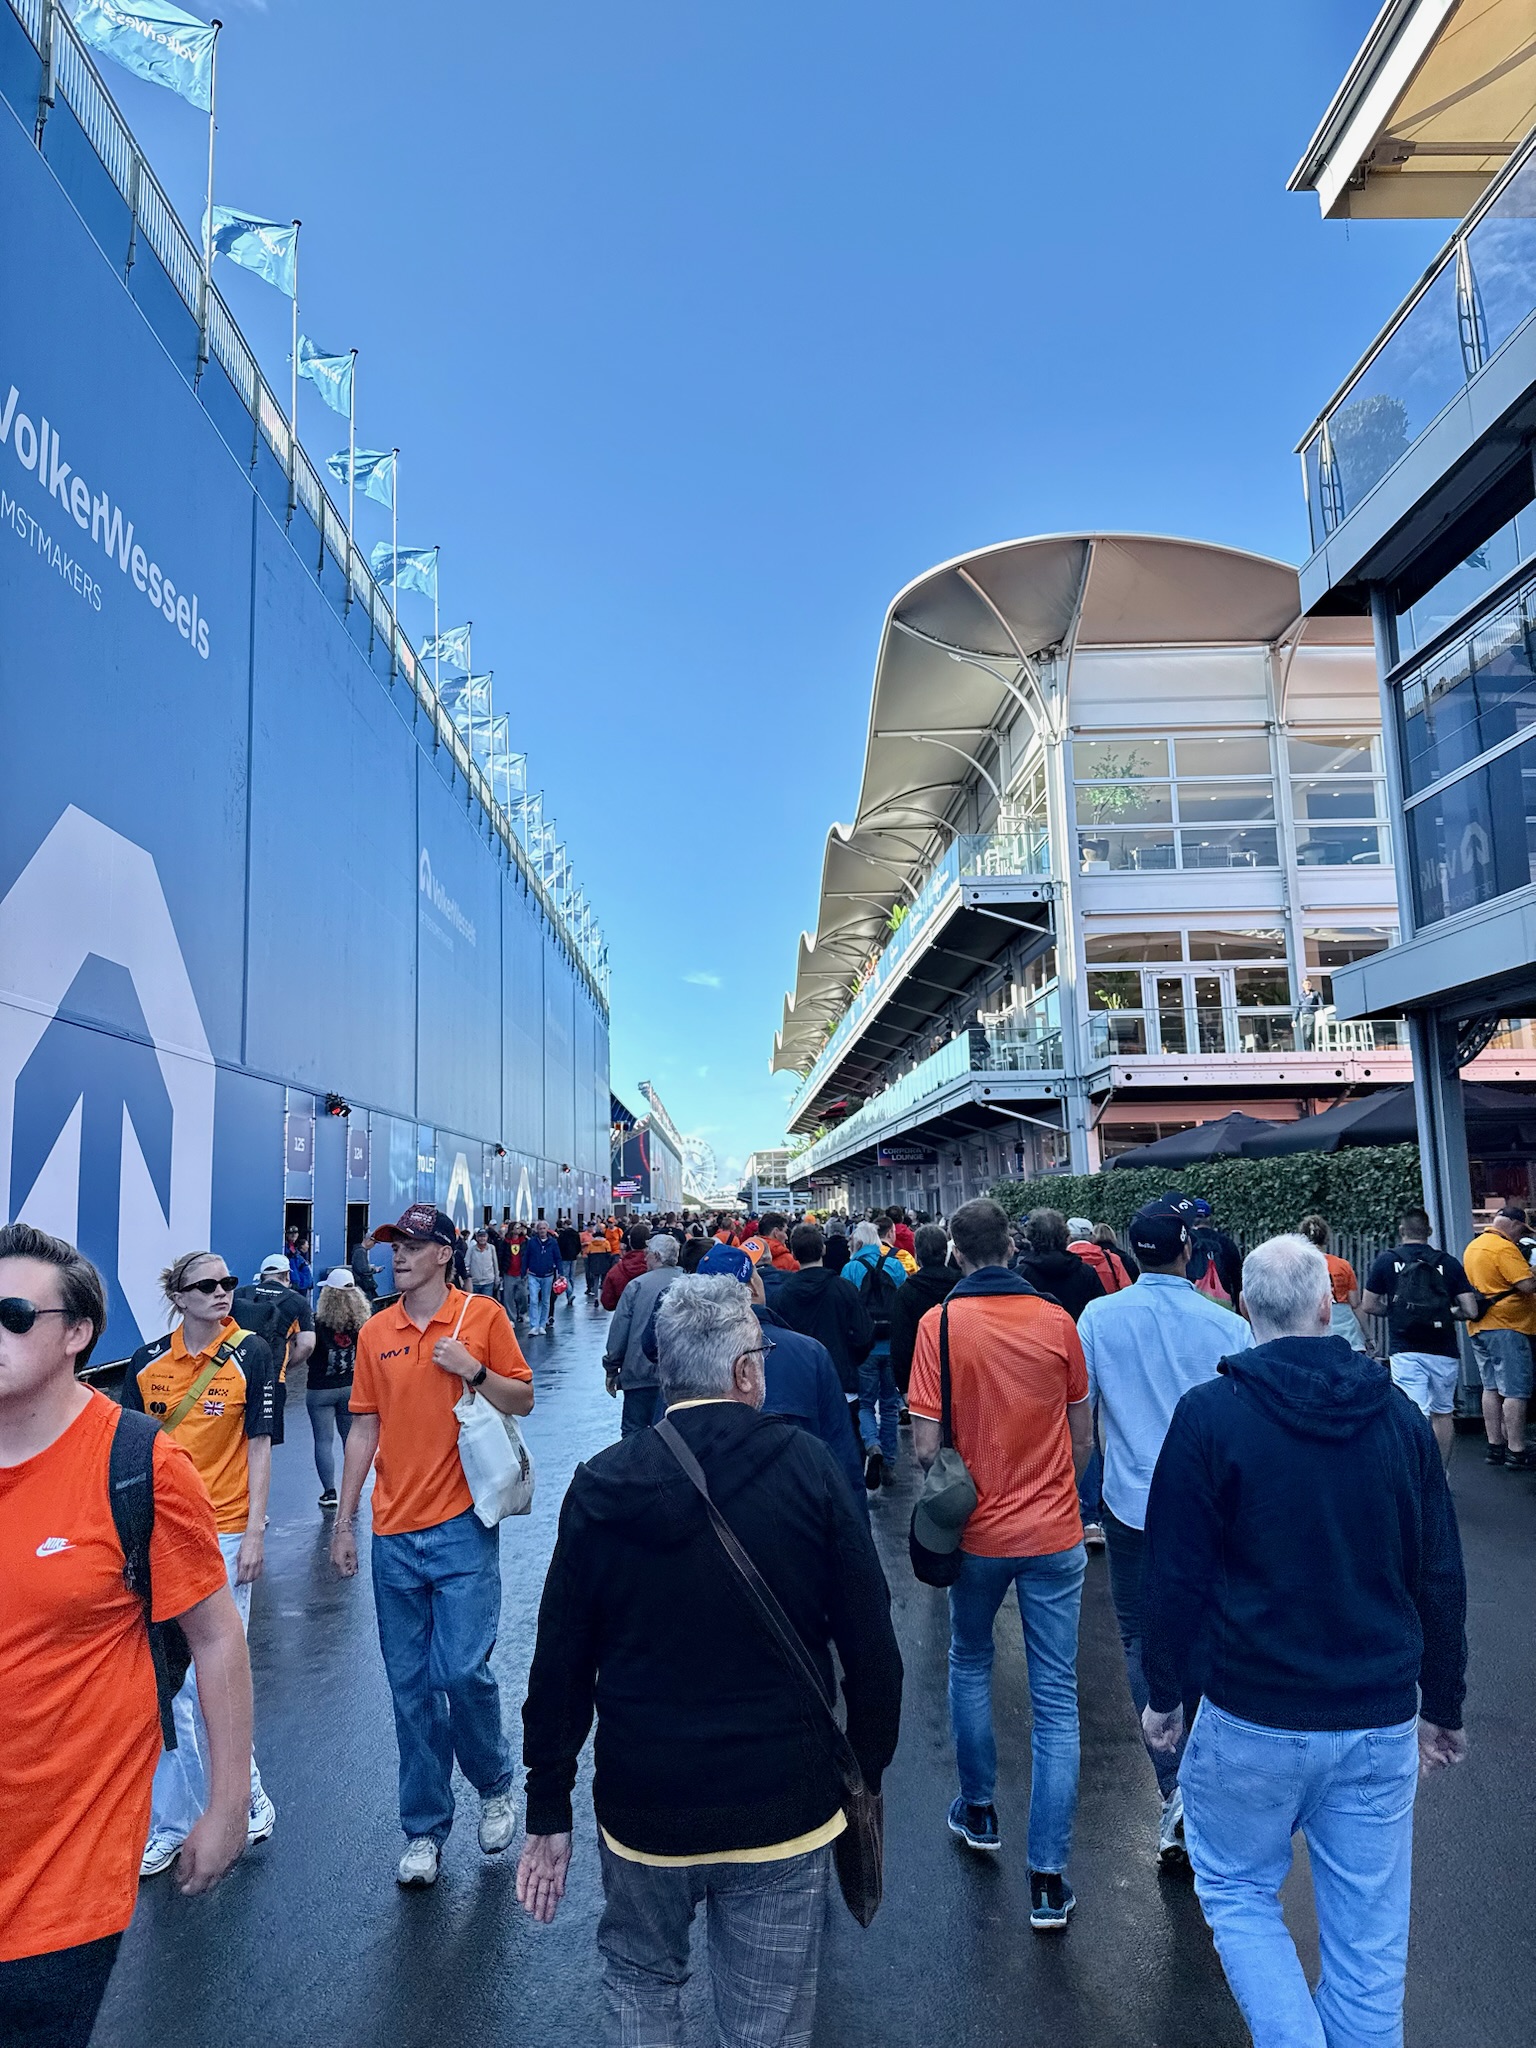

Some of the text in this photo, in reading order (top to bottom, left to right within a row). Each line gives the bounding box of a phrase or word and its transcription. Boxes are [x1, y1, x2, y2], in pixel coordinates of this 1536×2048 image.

[0, 384, 210, 660] VolkerWessels
[294, 1136, 305, 1152] 125
[882, 1147, 933, 1155] CORPORATE
[43, 1536, 69, 1550] NIKE
